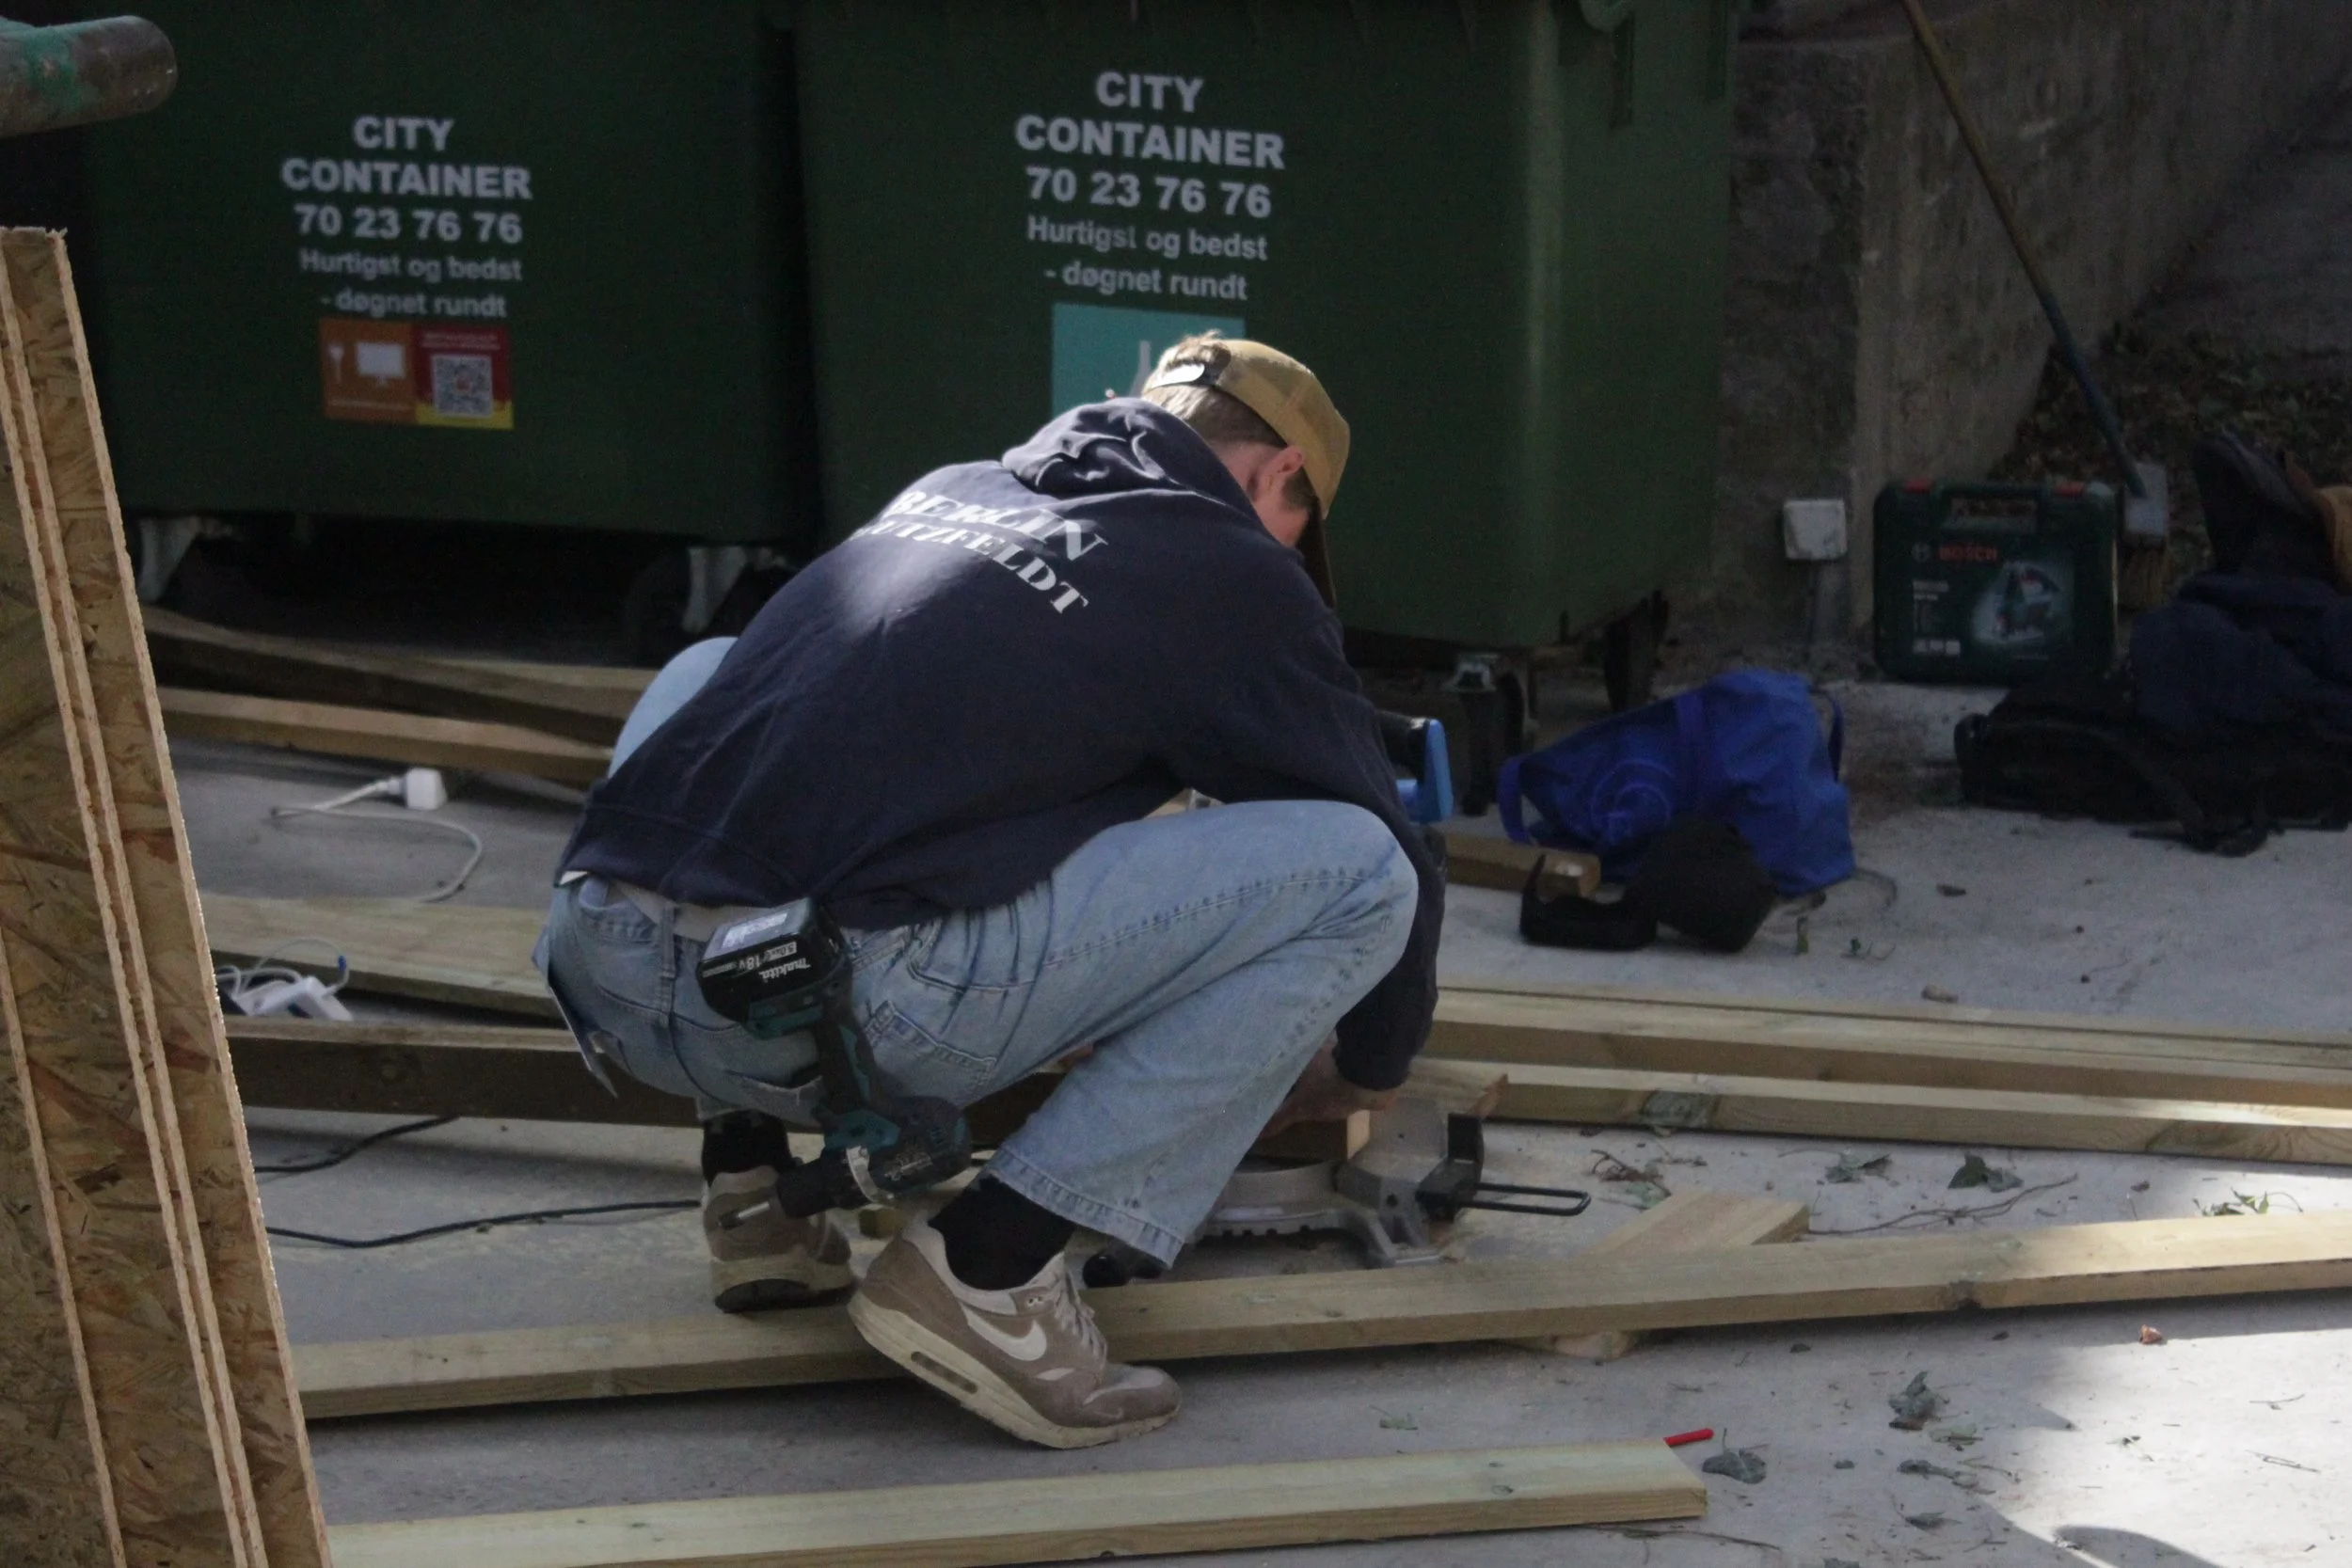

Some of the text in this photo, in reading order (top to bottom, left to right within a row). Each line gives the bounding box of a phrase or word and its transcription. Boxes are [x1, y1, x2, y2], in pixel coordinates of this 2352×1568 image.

[1095, 71, 1204, 113] CITY
[353, 116, 453, 151] CITY
[1015, 114, 1285, 169] CONTAINER
[280, 158, 532, 199] CONTAINER
[1025, 166, 1271, 218] 70 23 76 76
[294, 203, 522, 244] 70 23 76 76
[1027, 214, 1268, 261] Hurtigst og bedst
[299, 247, 522, 282] Hurtigst og bedst
[1062, 261, 1163, 295] døgnet
[1169, 274, 1248, 301] rundt
[335, 287, 428, 317] døgnet
[433, 294, 506, 318] rundt
